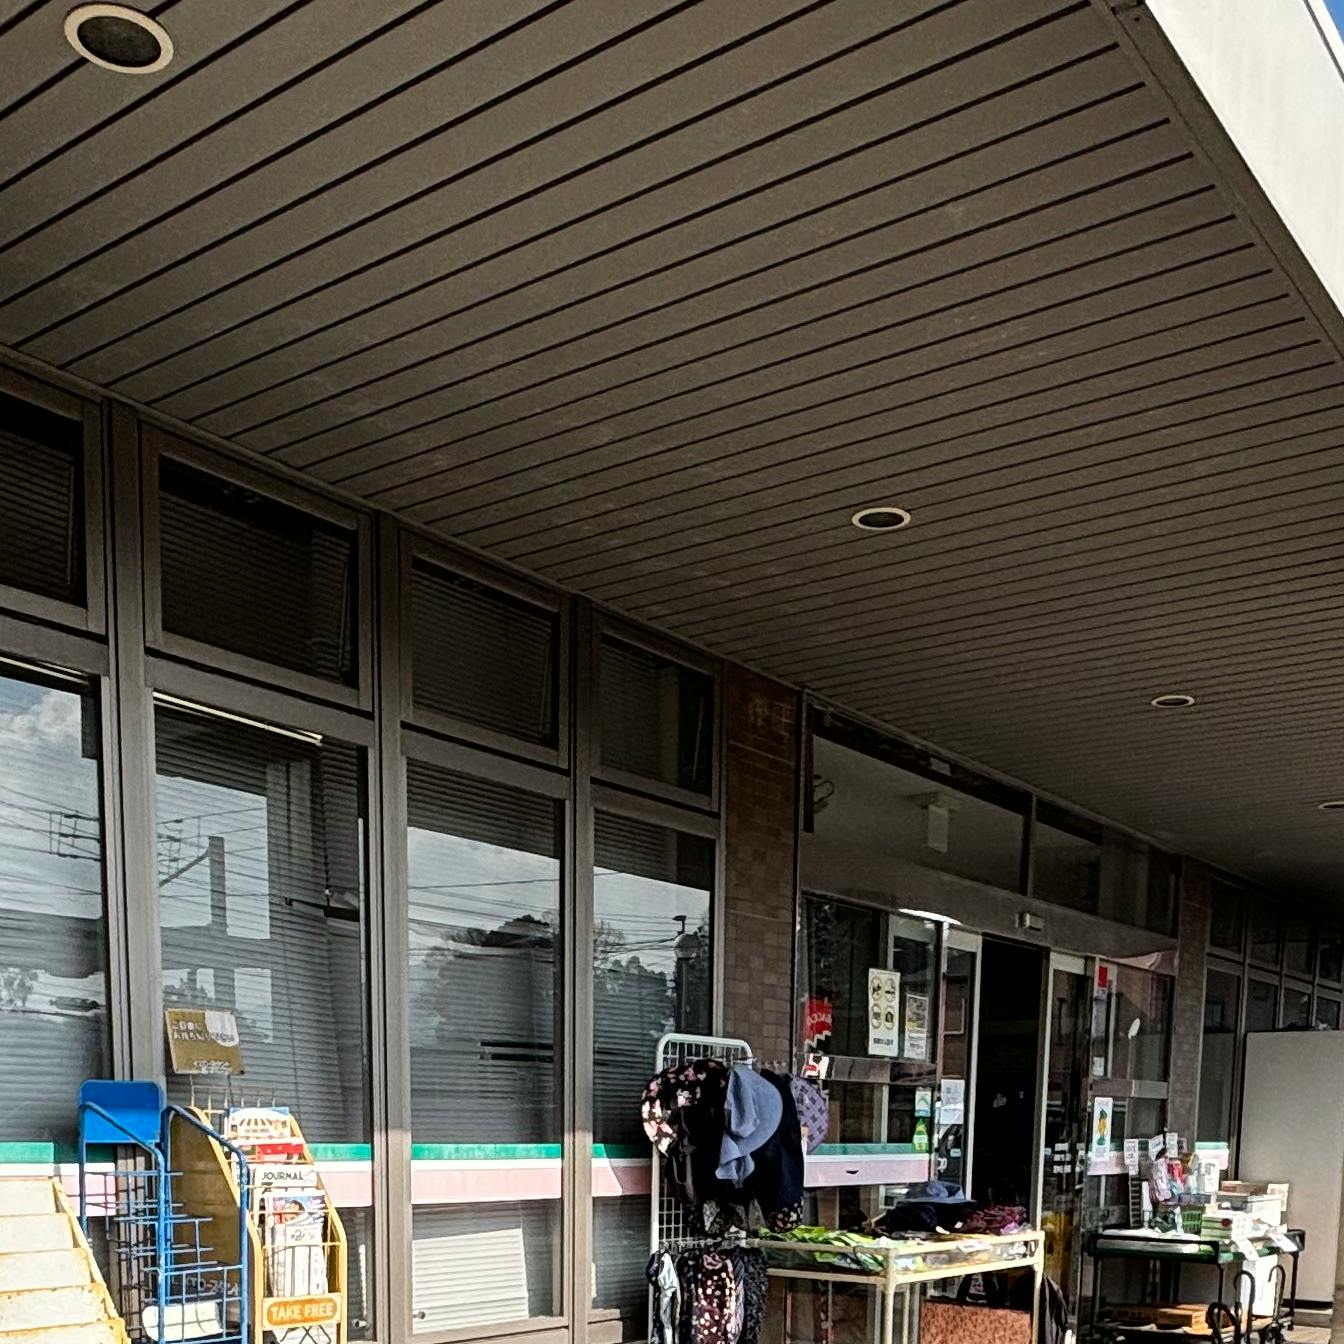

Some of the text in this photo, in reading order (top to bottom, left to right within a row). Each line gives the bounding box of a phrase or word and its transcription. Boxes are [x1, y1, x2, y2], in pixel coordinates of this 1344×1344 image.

[262, 1170, 304, 1181] JOURNAL
[270, 1302, 334, 1320] TAKE FREE
